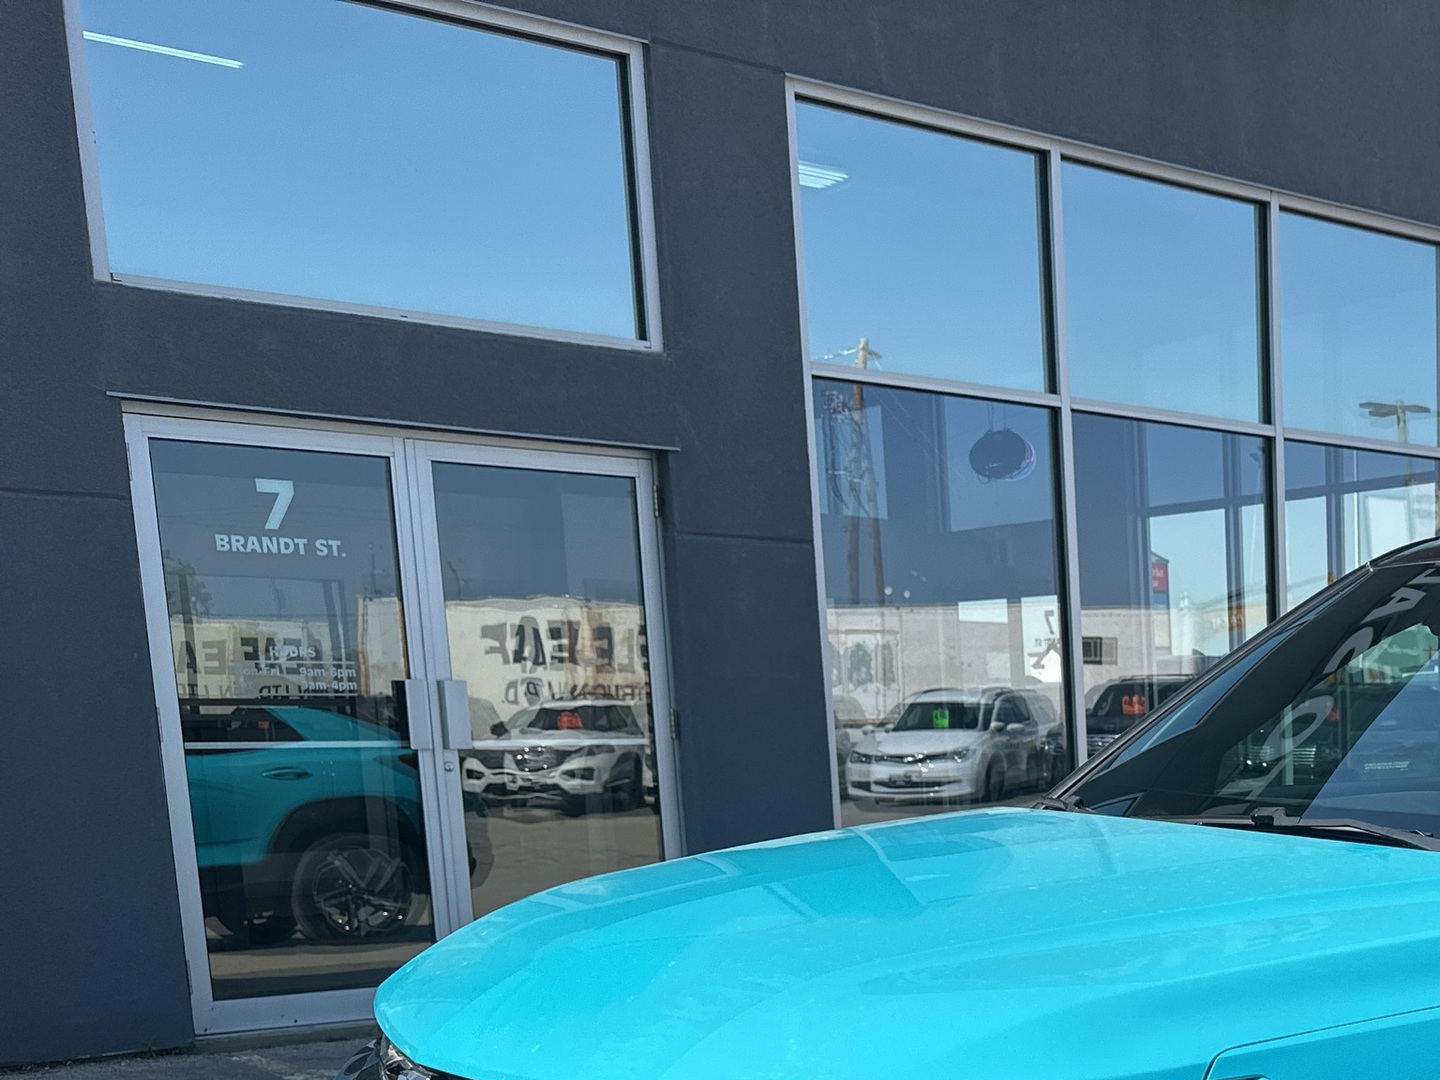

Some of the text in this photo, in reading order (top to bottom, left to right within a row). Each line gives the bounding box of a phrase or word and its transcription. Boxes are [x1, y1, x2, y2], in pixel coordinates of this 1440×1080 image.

[255, 478, 294, 530] 7
[215, 534, 347, 557] BRANDT ST.
[300, 667, 357, 680] 9am-6pm
